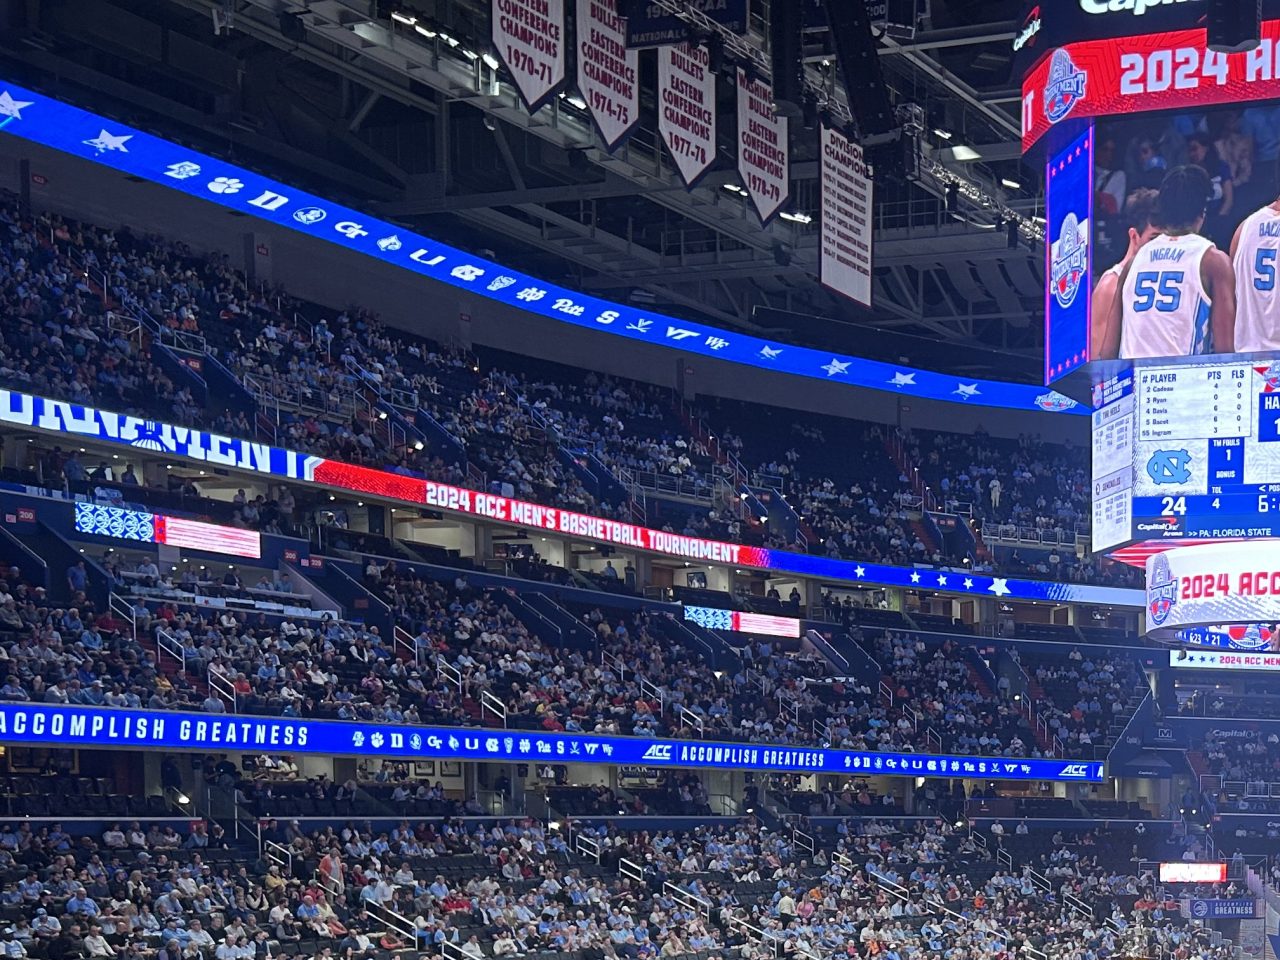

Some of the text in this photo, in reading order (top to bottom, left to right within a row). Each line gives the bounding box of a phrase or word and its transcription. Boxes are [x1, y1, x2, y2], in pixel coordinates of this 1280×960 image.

[500, 16, 557, 58] CHAMPIONS
[590, 27, 626, 61] EASTERN
[507, 45, 551, 84] 1970-71
[581, 41, 635, 84] CONFERENCE
[671, 51, 704, 81] BULLETS
[1120, 47, 1229, 95] 2024
[583, 61, 632, 100] CHAMPIONS
[671, 74, 704, 105] EASTERN
[588, 88, 628, 125] 1974-75
[663, 88, 712, 126] CONFERENCE
[664, 106, 709, 141] CHAMPIONS
[749, 119, 778, 146] EASTERN
[669, 132, 706, 164] 1977-78
[741, 131, 785, 166] CONFERENCE
[743, 148, 783, 180] CHAMPIONS
[748, 172, 780, 202] 1978-79
[1150, 247, 1184, 264] INGRAM
[1253, 248, 1278, 291] 5
[1133, 270, 1185, 312] 55
[1150, 370, 1245, 384] PLAYER PTS FLS
[1213, 438, 1241, 447] TM FOULS
[1225, 449, 1232, 461] 1
[1161, 496, 1187, 516] 24
[1212, 498, 1220, 509] 4
[426, 483, 740, 563] 2024 ACC MEN'S BASKETBALL TOURNAMENT
[1213, 528, 1272, 537] FLORIDA STATE
[1181, 573, 1230, 599] 2024
[1219, 656, 1241, 665] 2024
[1244, 656, 1261, 665] ACC
[0, 711, 308, 745] ACCOMPLISH GREATNESS
[645, 745, 824, 767] ACC ACCOMPLISH GREATNESS
[1061, 764, 1087, 775] ACC
[1215, 907, 1253, 915] GREATNESS
